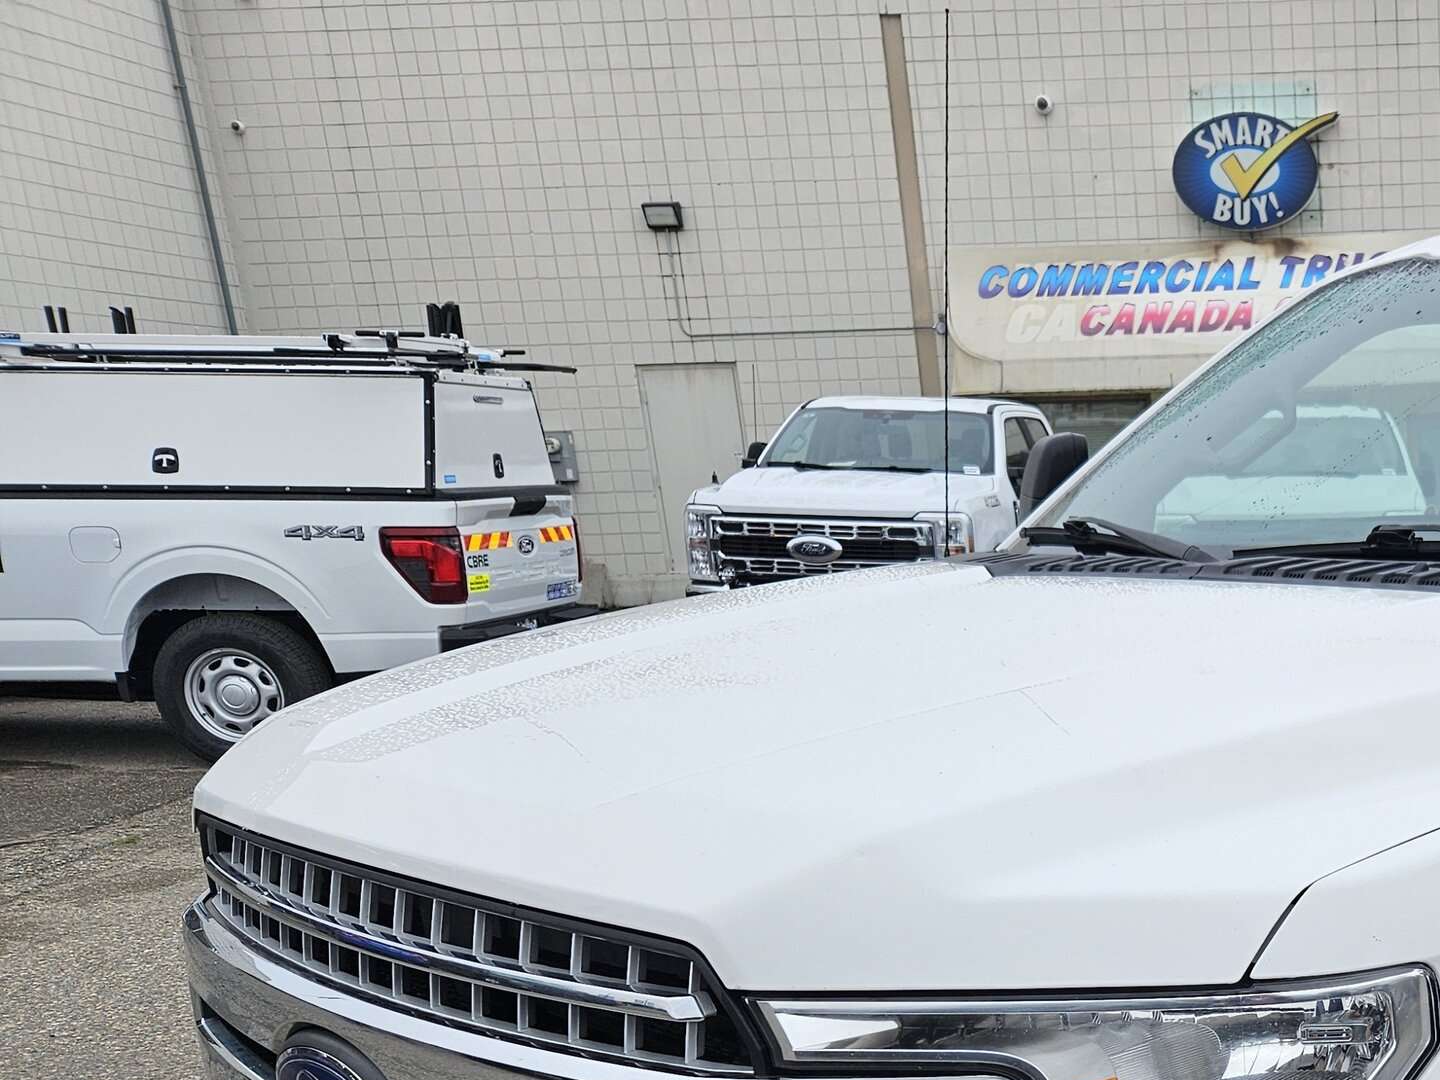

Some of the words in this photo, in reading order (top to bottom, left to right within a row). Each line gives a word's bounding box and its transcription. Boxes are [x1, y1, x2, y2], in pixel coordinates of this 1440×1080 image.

[1194, 117, 1291, 159] SMART
[1213, 192, 1284, 225] BUY!
[978, 255, 1261, 299] COMMERCIAL
[1280, 251, 1388, 289] TR
[1080, 298, 1252, 337] CANADA
[467, 554, 489, 569] CBRE
